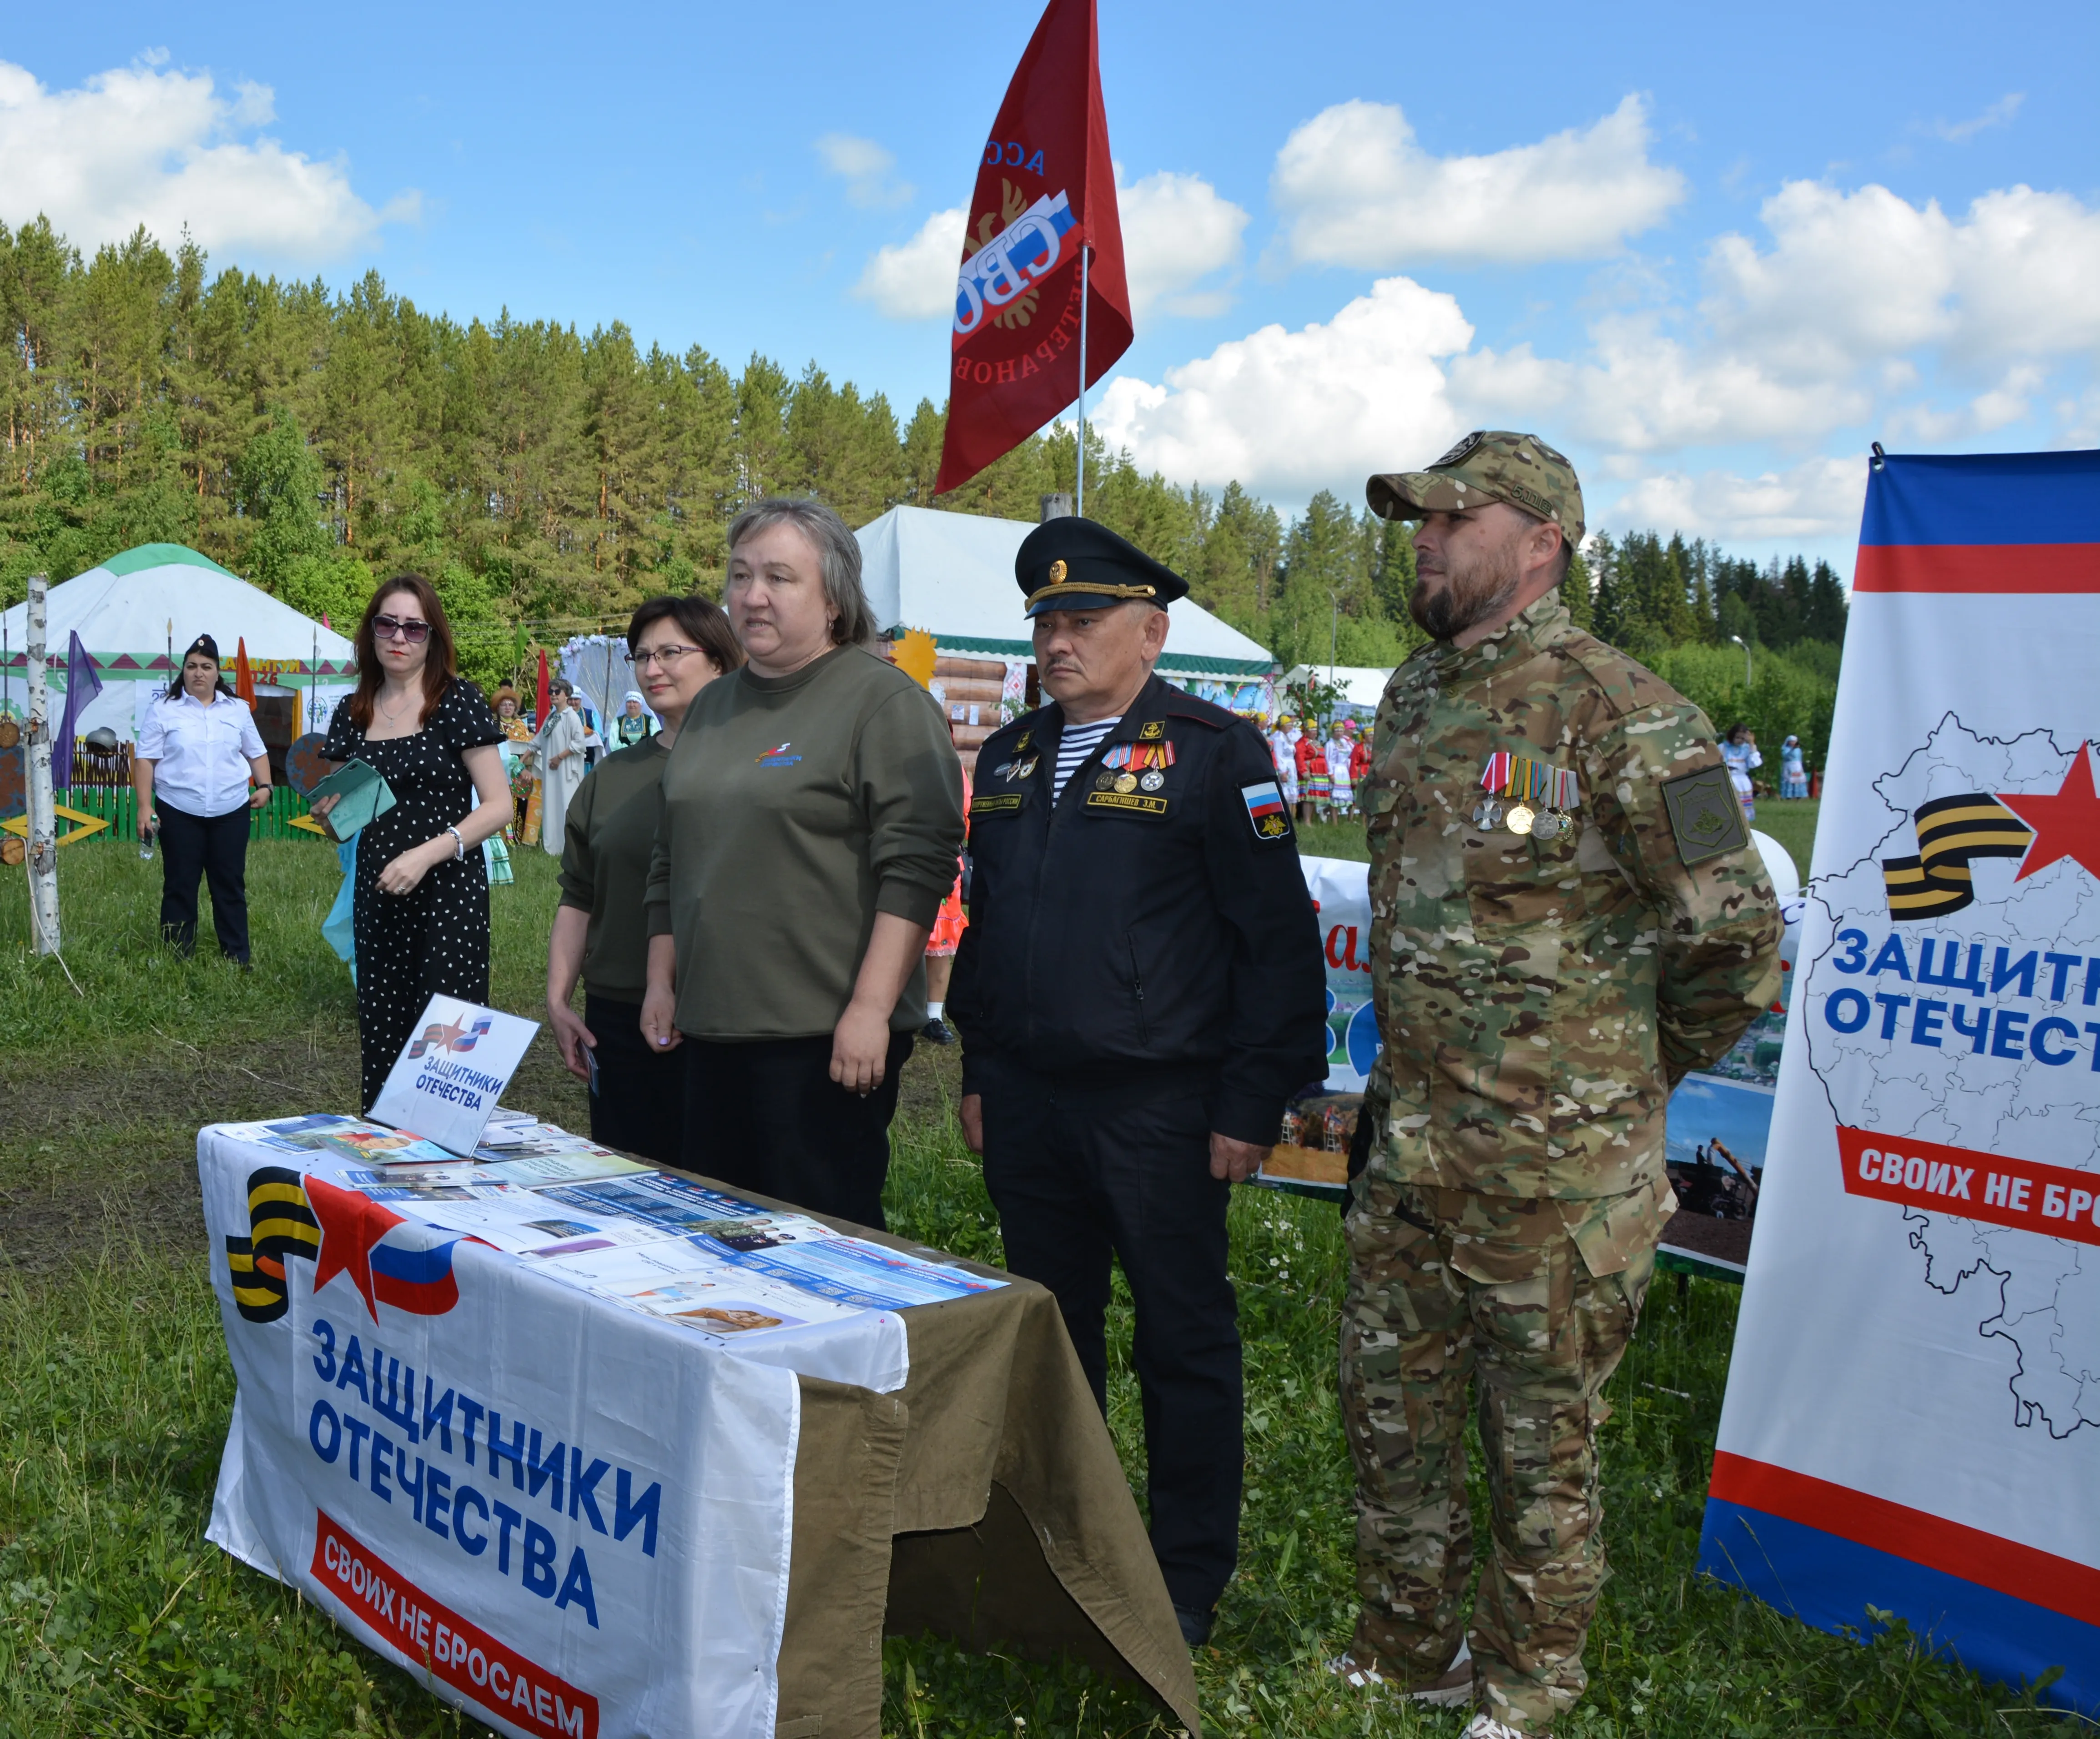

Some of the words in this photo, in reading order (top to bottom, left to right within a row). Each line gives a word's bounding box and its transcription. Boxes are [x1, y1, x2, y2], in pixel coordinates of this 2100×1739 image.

[220, 657, 300, 673] ААНТУЙ
[251, 670, 278, 685] 026
[416, 1074, 482, 1111] ОТЕЧЕСТВА
[424, 1056, 503, 1095] ЗАЩИТНИКИ
[1859, 1148, 1975, 1200] СВОИХ
[1984, 1172, 2032, 1212] НЕ
[312, 1319, 661, 1558] ЗАЩИТНИКИ
[309, 1399, 599, 1630] ОТЕЧЕСТВА
[325, 1535, 396, 1625] СВОИХ
[399, 1596, 431, 1650] НЕ
[434, 1622, 584, 1739] БРОСАЕМ
